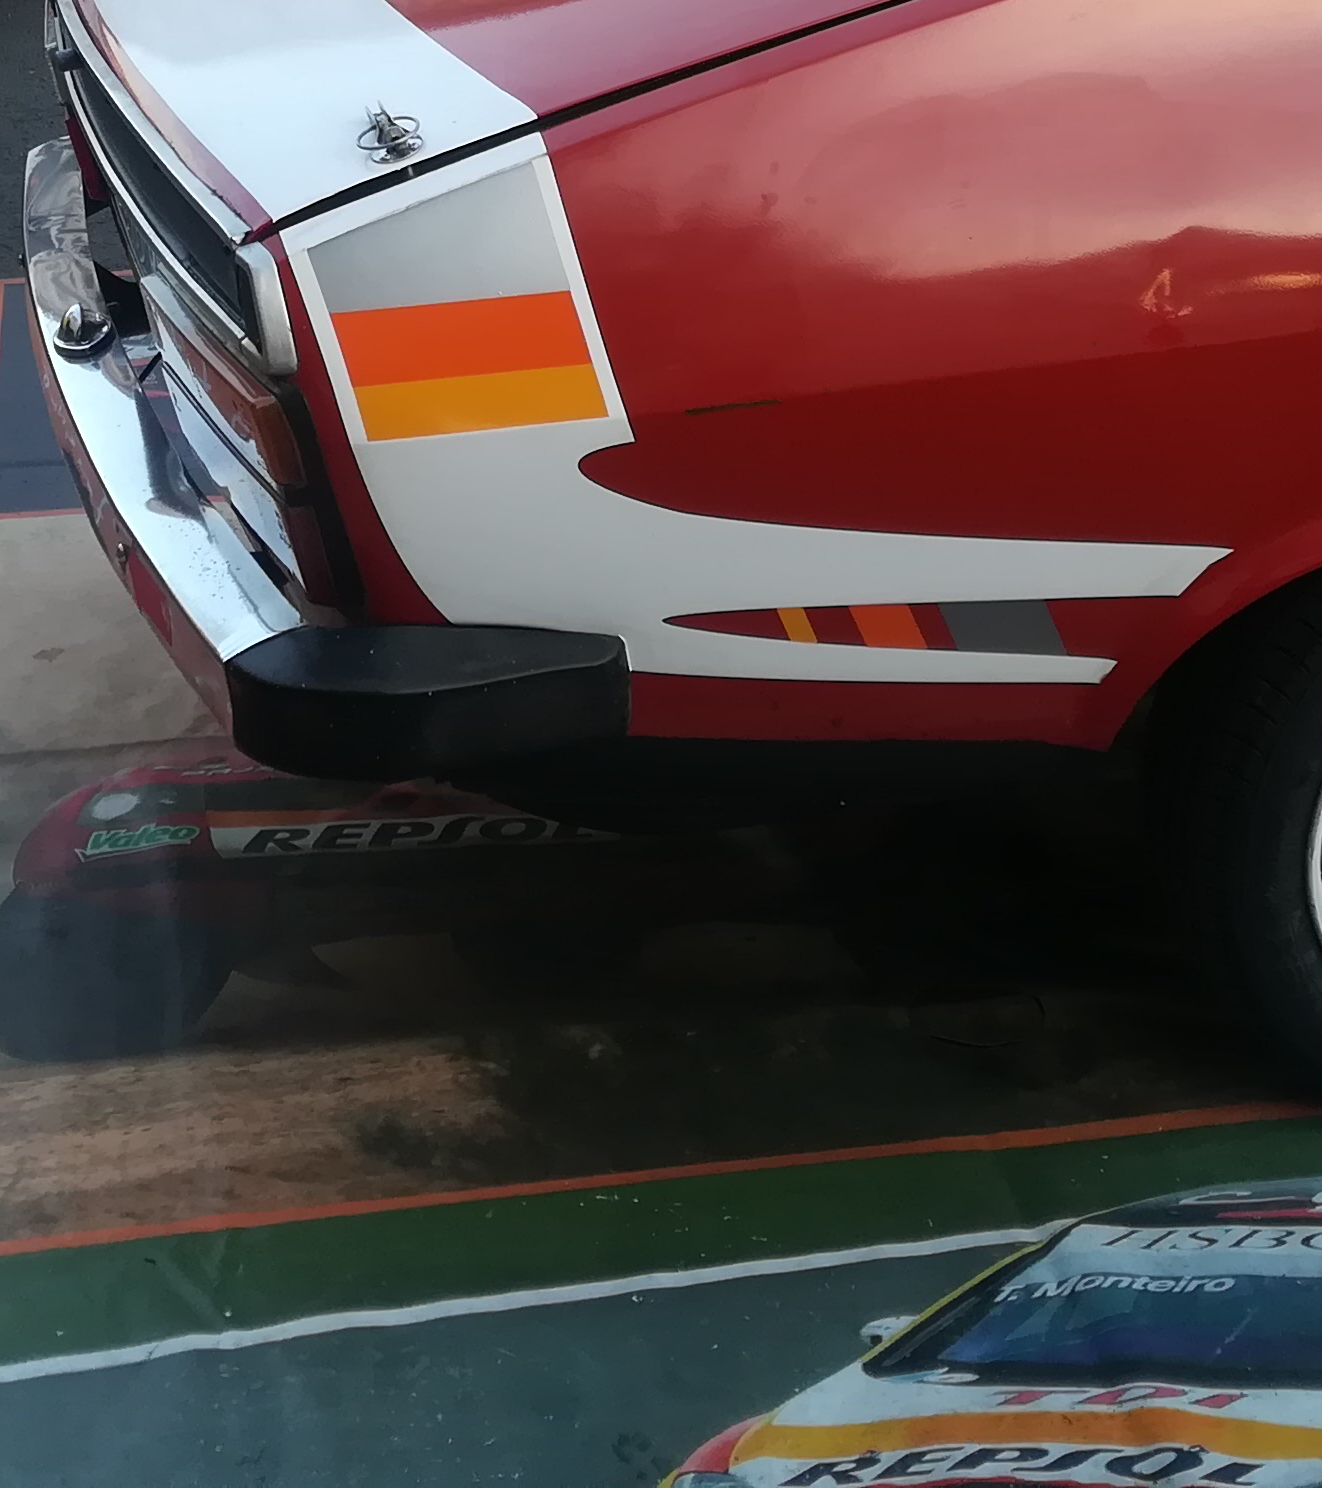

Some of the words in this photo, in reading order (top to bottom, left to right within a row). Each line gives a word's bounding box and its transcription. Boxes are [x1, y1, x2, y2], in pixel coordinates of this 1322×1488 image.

[85, 824, 200, 852] Valeo
[1031, 1275, 1236, 1299] Monteiro
[778, 1444, 1266, 1487] REPSOL
